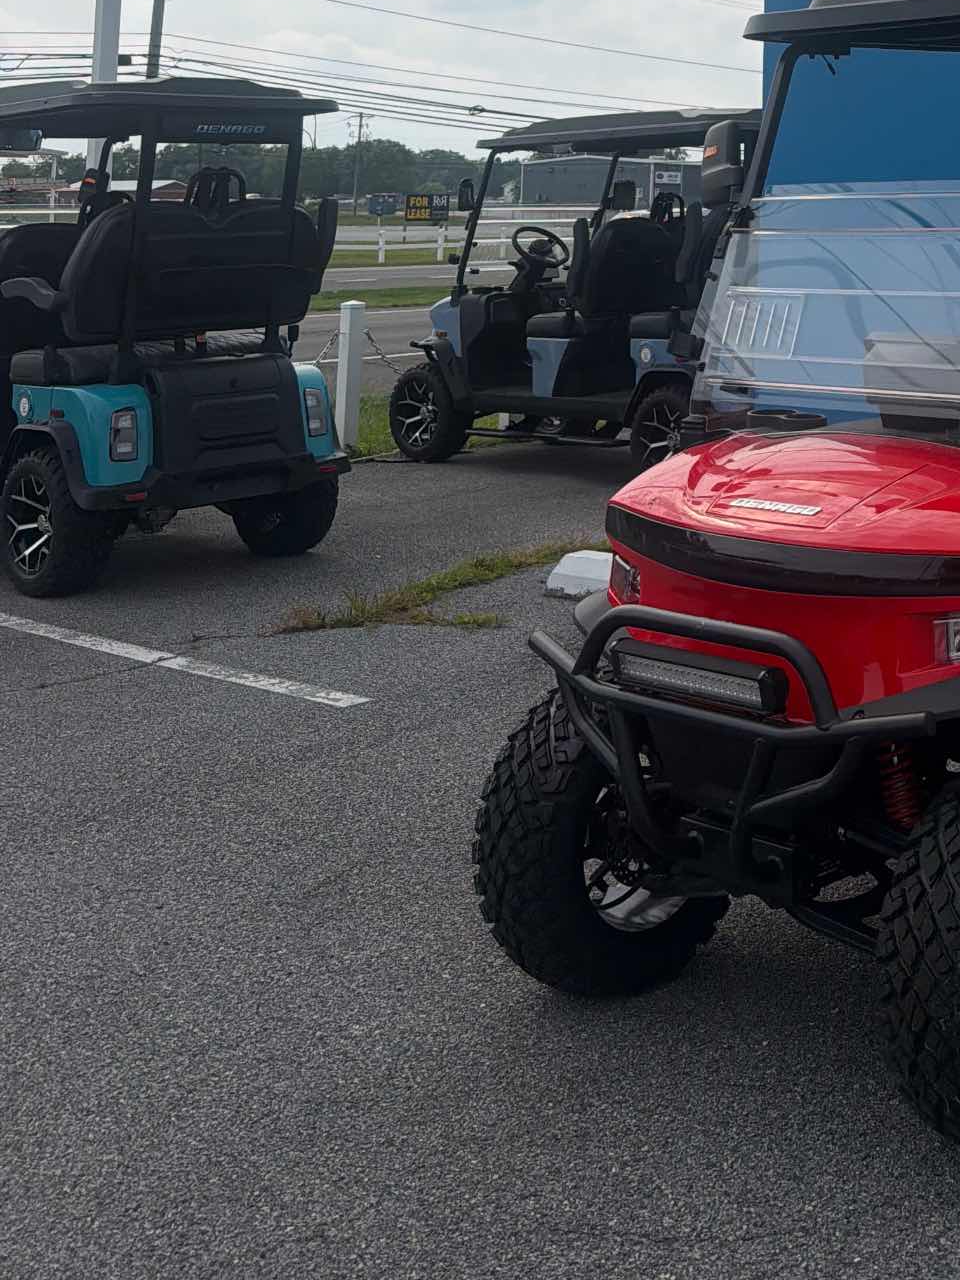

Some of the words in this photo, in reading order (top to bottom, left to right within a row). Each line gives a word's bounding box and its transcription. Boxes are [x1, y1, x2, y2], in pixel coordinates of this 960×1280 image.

[409, 195, 429, 207] FOR
[407, 208, 431, 220] LEASE
[729, 498, 822, 516] DENAGO
